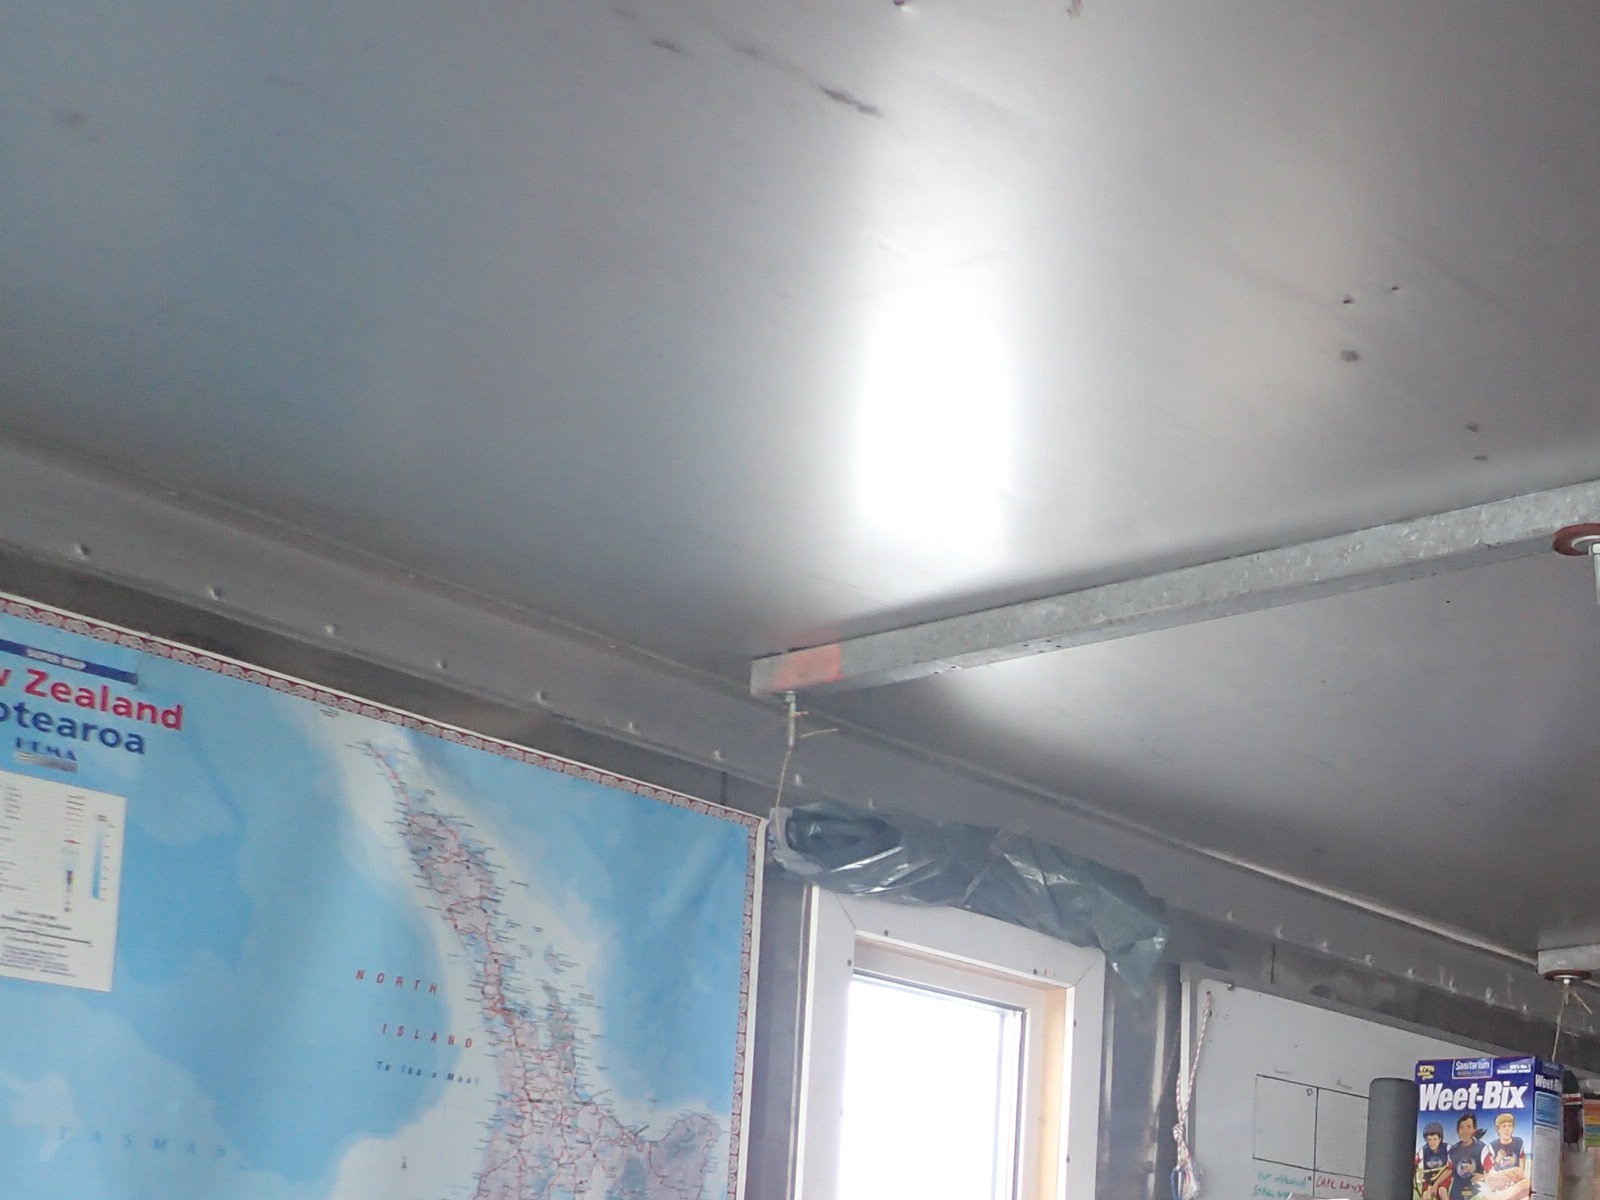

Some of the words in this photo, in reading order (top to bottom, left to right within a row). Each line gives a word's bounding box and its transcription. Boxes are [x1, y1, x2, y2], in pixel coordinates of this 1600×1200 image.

[25, 668, 183, 731] Zealand
[356, 970, 437, 995] NORTH
[382, 1023, 473, 1048] ISLAND
[1419, 1080, 1528, 1111] Weet-Bix
